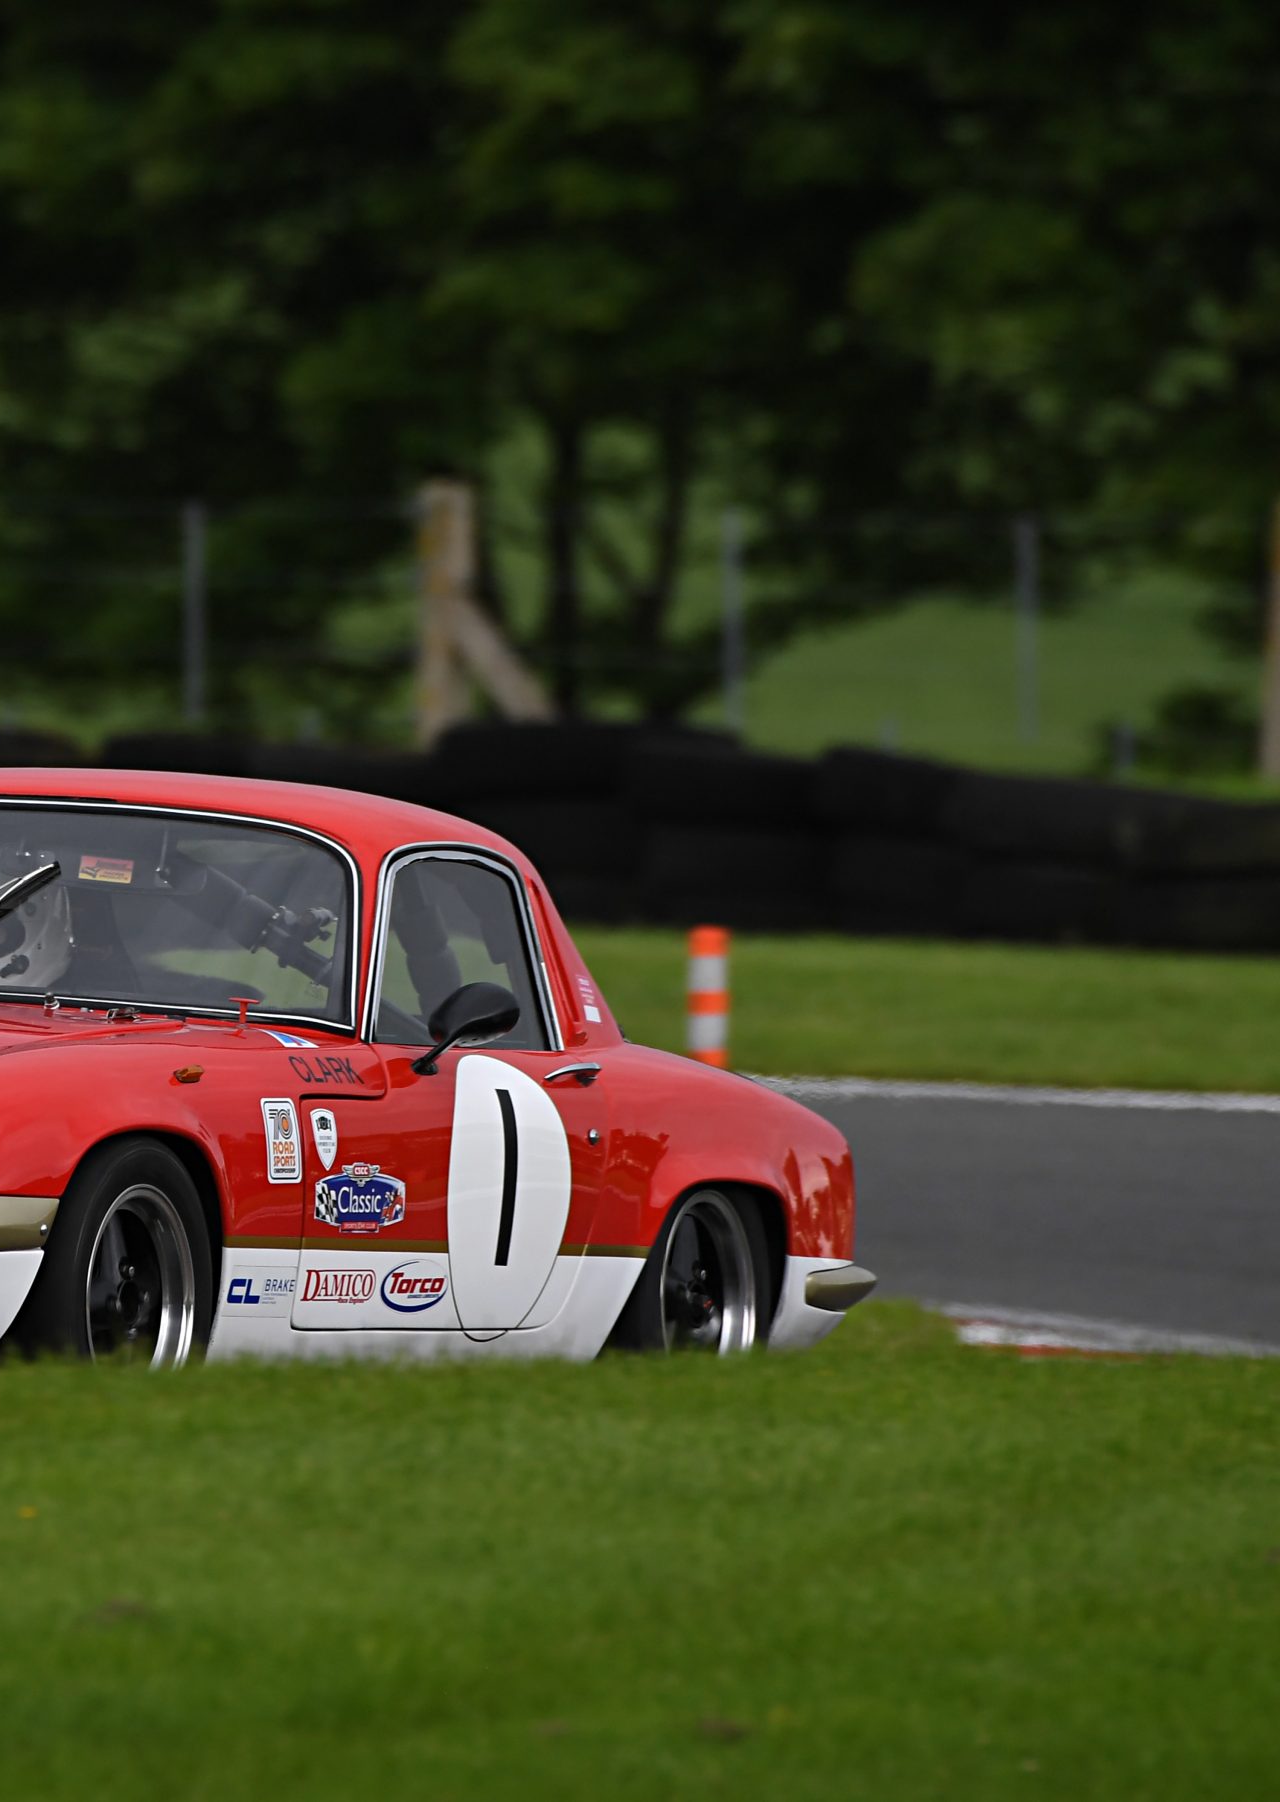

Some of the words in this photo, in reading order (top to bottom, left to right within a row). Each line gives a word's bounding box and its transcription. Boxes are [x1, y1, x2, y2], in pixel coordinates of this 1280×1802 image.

[288, 1056, 365, 1084] CLARK
[272, 1141, 295, 1154] ROAD
[273, 1155, 296, 1167] SPORTS
[495, 1089, 518, 1266] 1
[338, 1186, 382, 1213] Classic
[227, 1278, 260, 1304] CL
[264, 1278, 296, 1292] BRAKE
[300, 1269, 374, 1301] DAMICO
[389, 1272, 445, 1294] Torco
